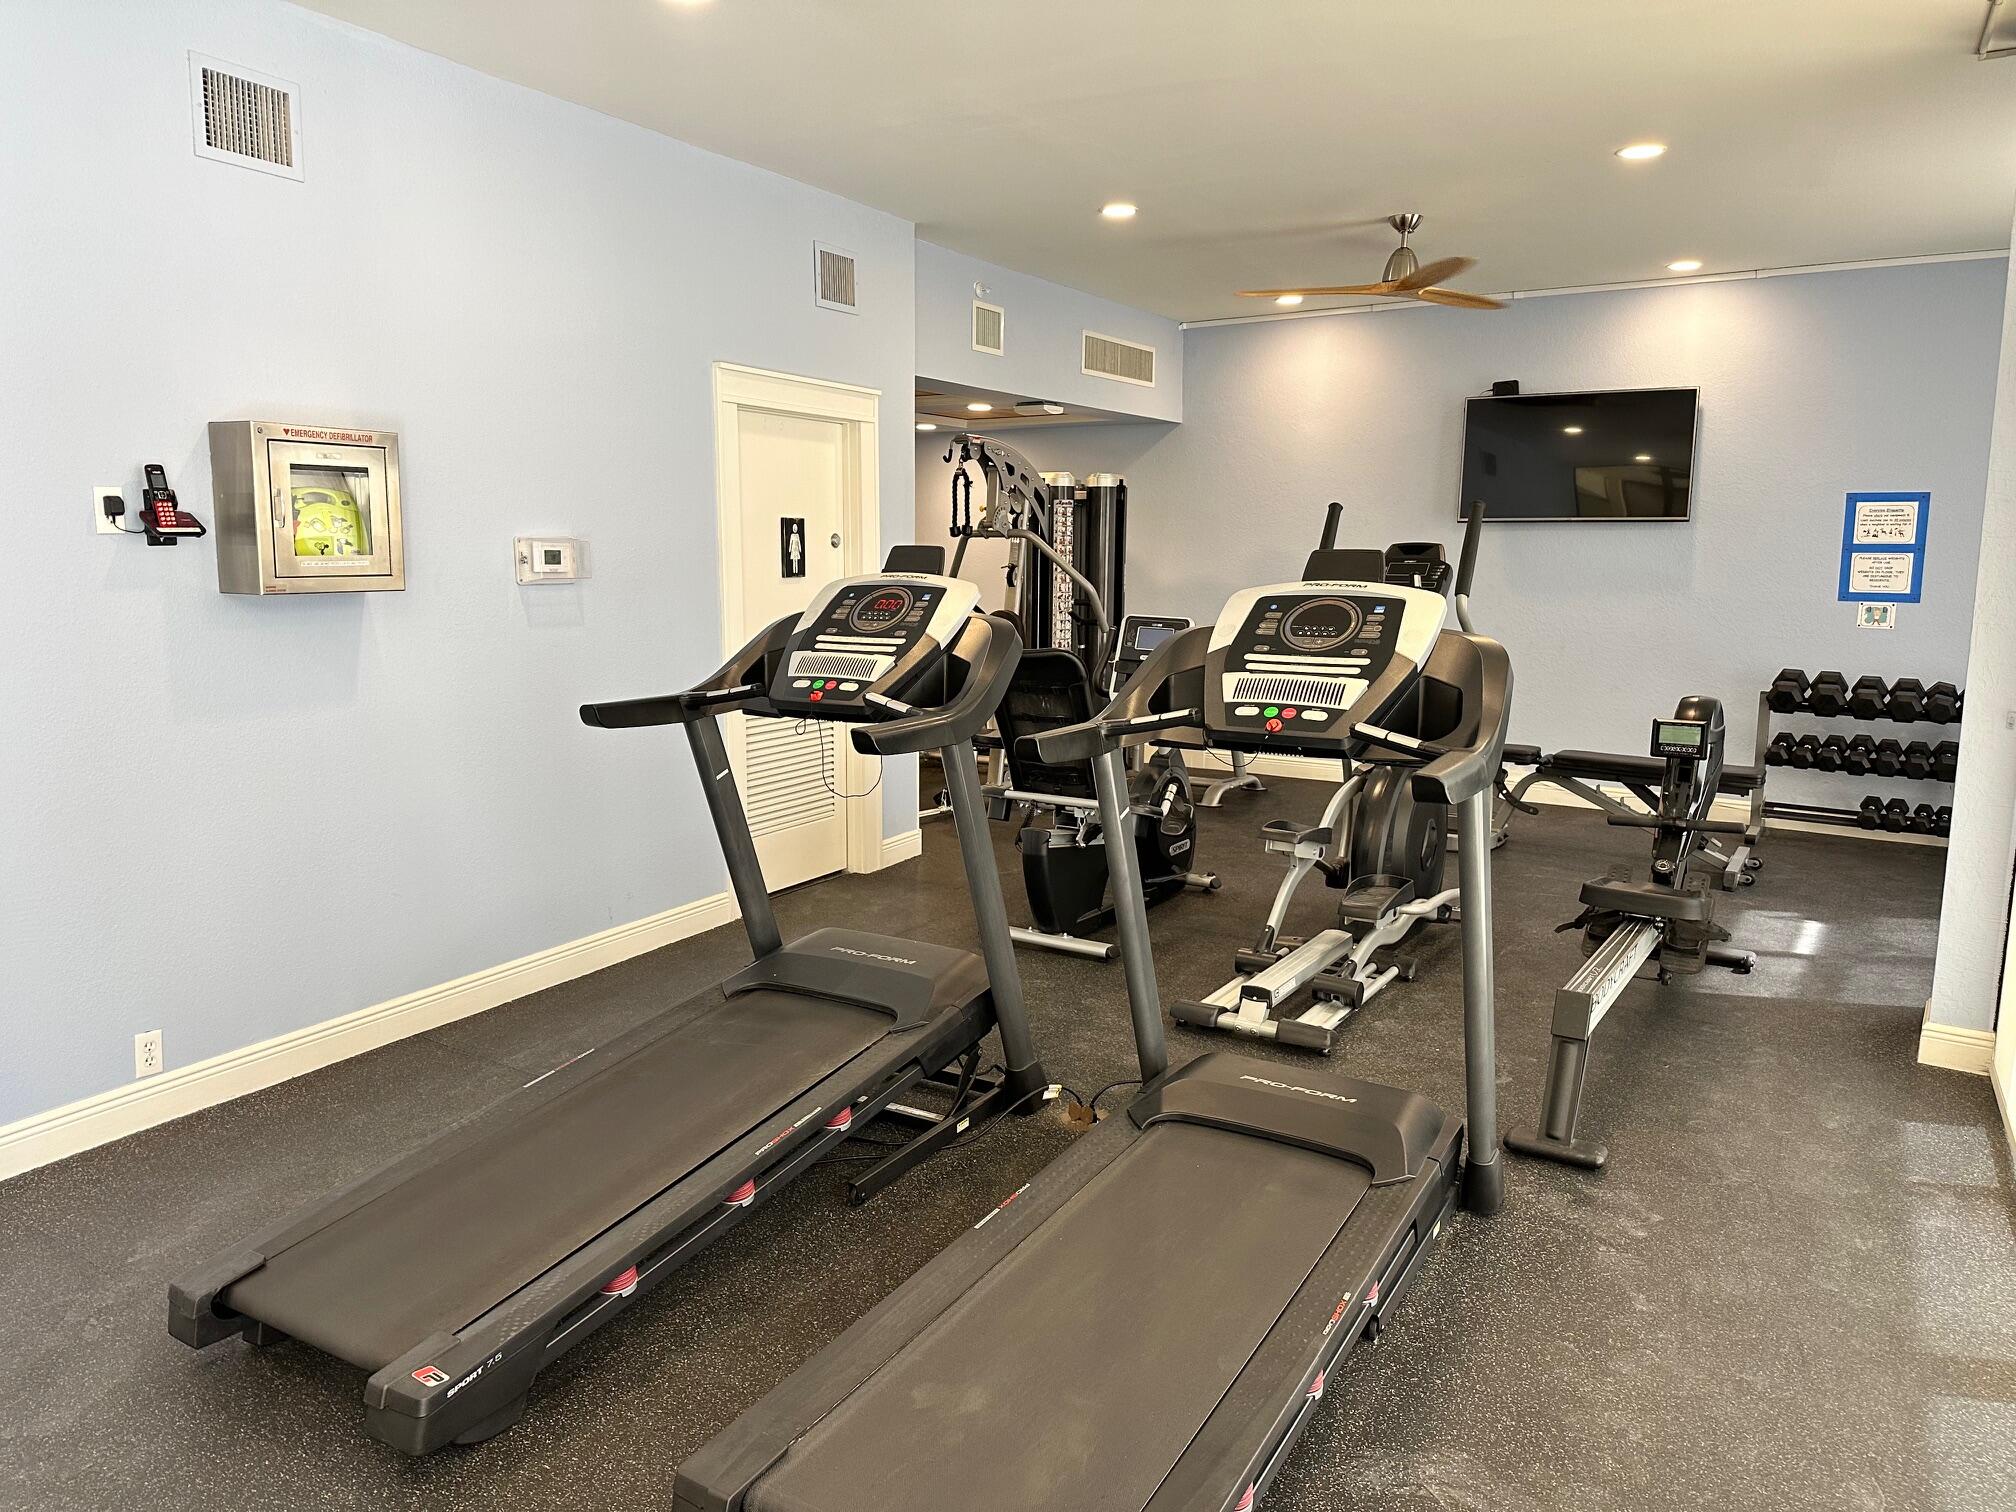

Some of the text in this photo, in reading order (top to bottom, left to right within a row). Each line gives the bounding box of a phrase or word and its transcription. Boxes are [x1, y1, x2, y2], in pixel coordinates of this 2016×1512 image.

[290, 428, 373, 443] EMERGENCY DEFIBRILLATOR
[1239, 1075, 1358, 1103] PRO-FORM
[446, 1365, 484, 1399] SPORT
